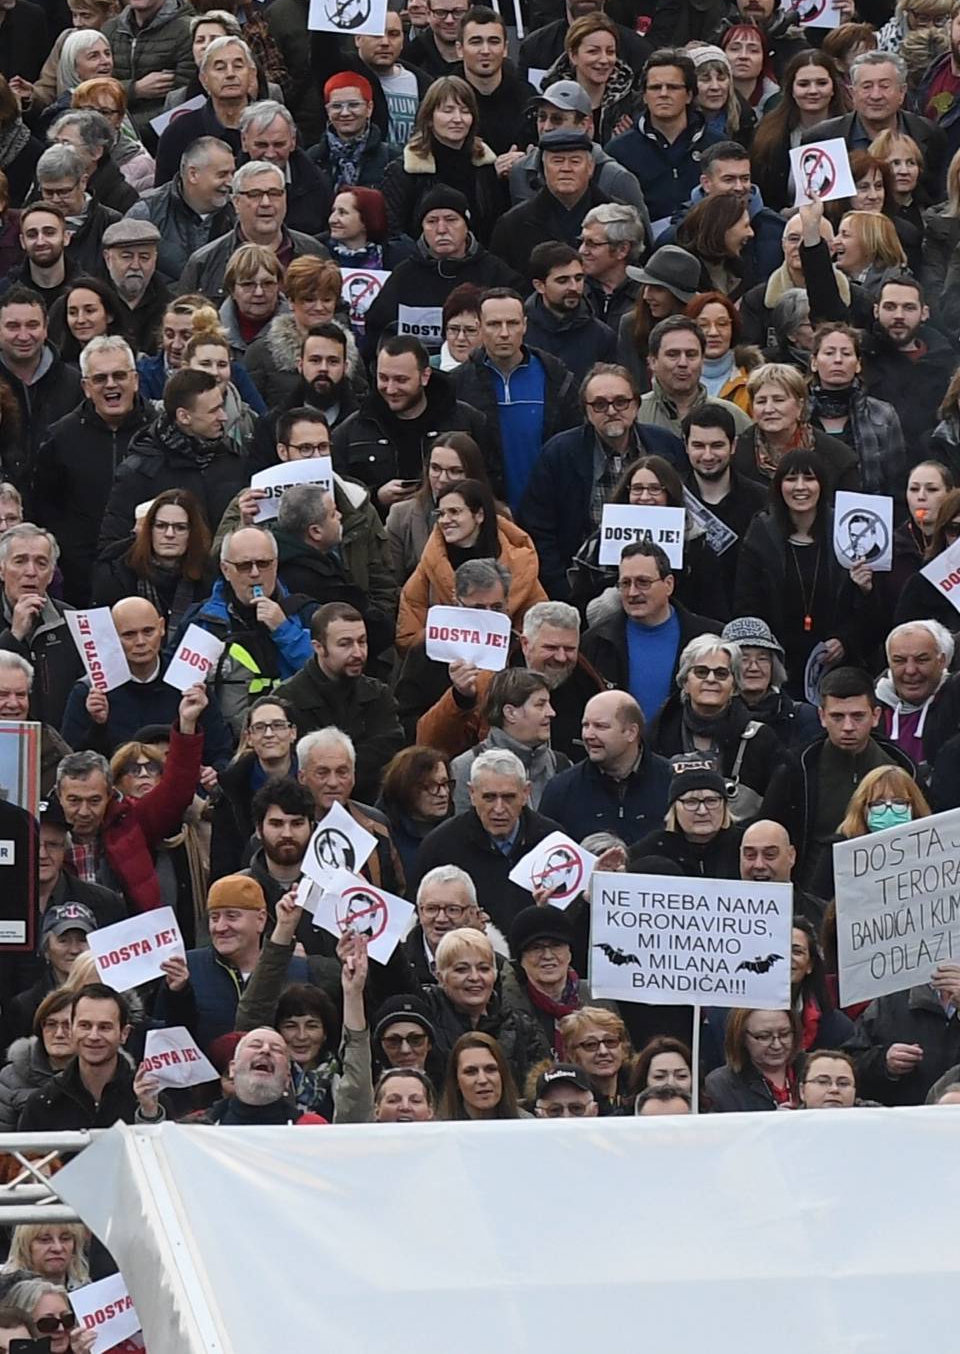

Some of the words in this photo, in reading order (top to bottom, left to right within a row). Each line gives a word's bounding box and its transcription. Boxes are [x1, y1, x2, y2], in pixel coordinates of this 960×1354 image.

[604, 526, 654, 542] DOSTA
[657, 529, 681, 544] JE!
[75, 614, 91, 635] JE!
[428, 626, 481, 644] DOSTA
[484, 632, 508, 648] JE!
[178, 647, 213, 672] DOS
[853, 827, 945, 878] DOSTA
[601, 889, 631, 908] NE
[637, 892, 710, 912] TREBA
[717, 896, 780, 915] NAMA
[606, 910, 773, 938] KORONAVIRUS,
[97, 939, 153, 969] DOSTA
[155, 928, 178, 950] JE!
[638, 933, 660, 949] MI
[669, 934, 742, 955] IMAMO
[870, 930, 953, 980] ODLAZI
[649, 953, 730, 974] MILANA
[632, 972, 747, 994] BANDIĆA!!!
[142, 1050, 182, 1073] OSTA
[181, 1047, 202, 1062] JE!
[82, 1295, 134, 1330] DOSTA
